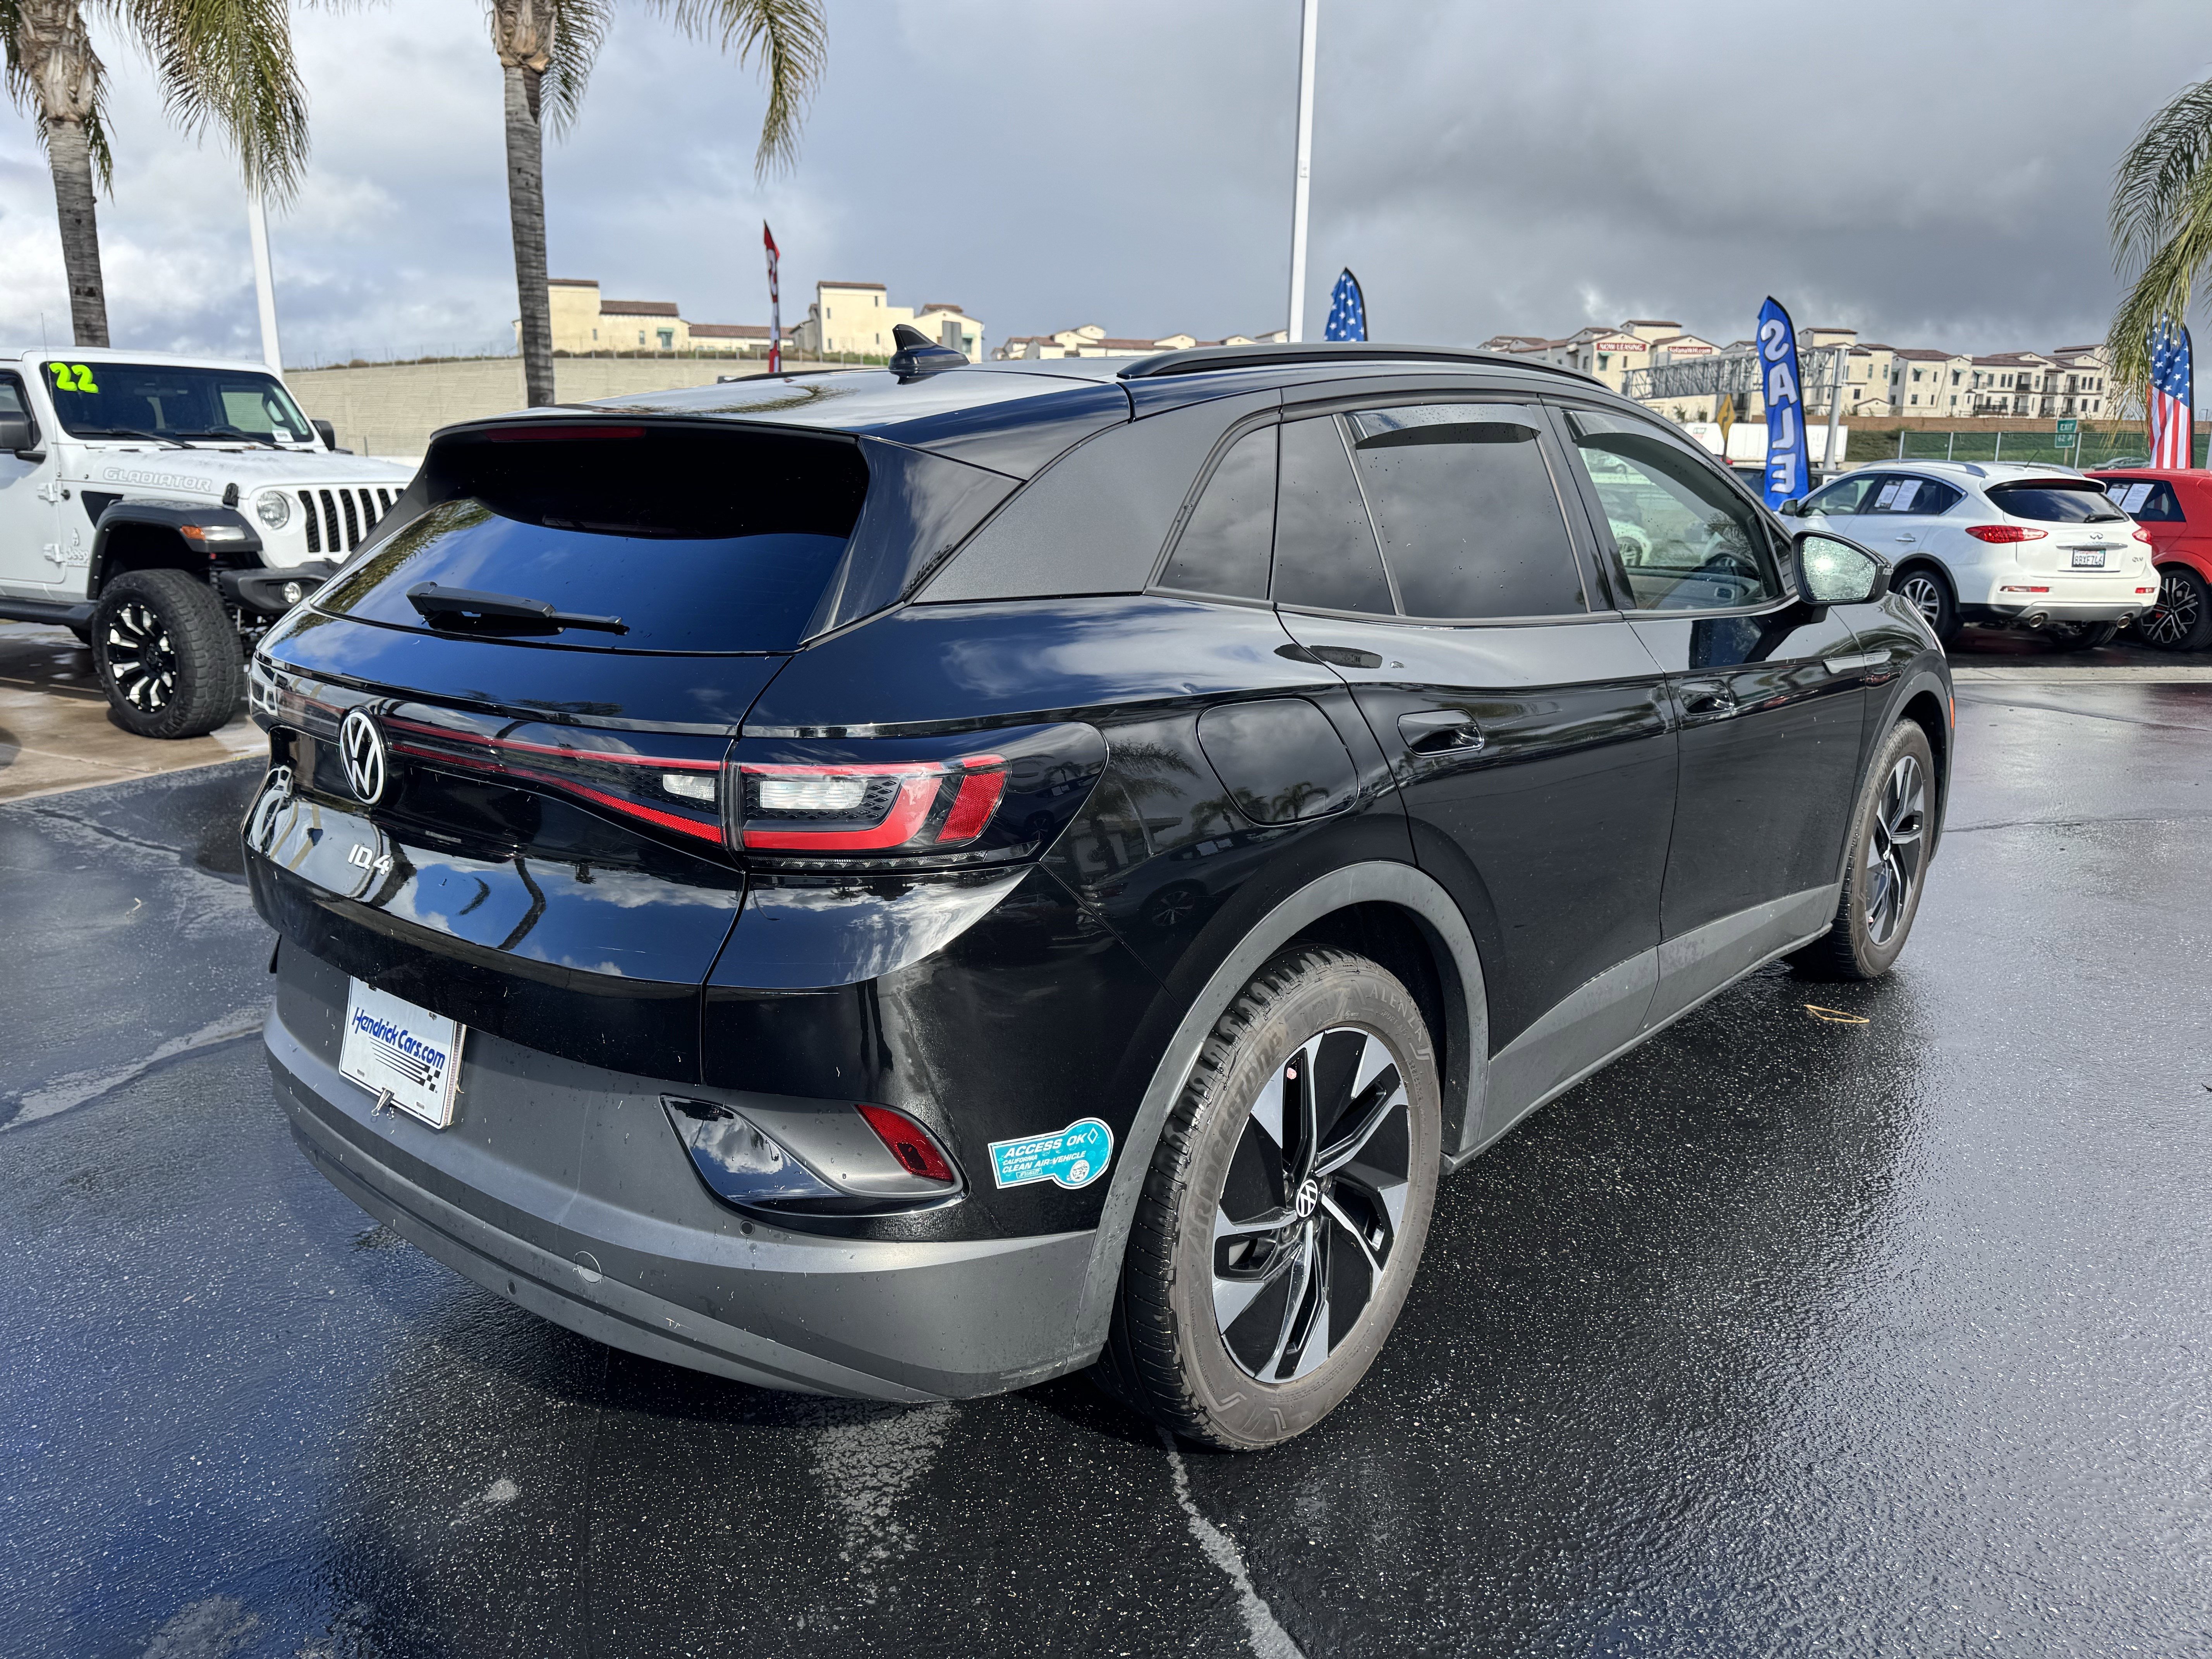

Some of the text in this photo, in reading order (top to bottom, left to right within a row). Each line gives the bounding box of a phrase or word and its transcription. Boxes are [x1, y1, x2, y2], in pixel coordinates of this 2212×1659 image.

[49, 362, 99, 393] 22
[2060, 423, 2074, 431] EXIT
[103, 467, 212, 492] GLADIATOR
[348, 844, 390, 875] ID.4
[1369, 983, 1424, 1043] ALENZA
[1379, 1009, 1398, 1025] SPORT
[1004, 1132, 1087, 1158] ACCESS OK
[1187, 1032, 1283, 1255] BRIDGESTONE
[1002, 1154, 1038, 1166] CALIFORNIA
[1002, 1161, 1033, 1173] CLEAN
[1052, 1150, 1087, 1165] VEHICLE
